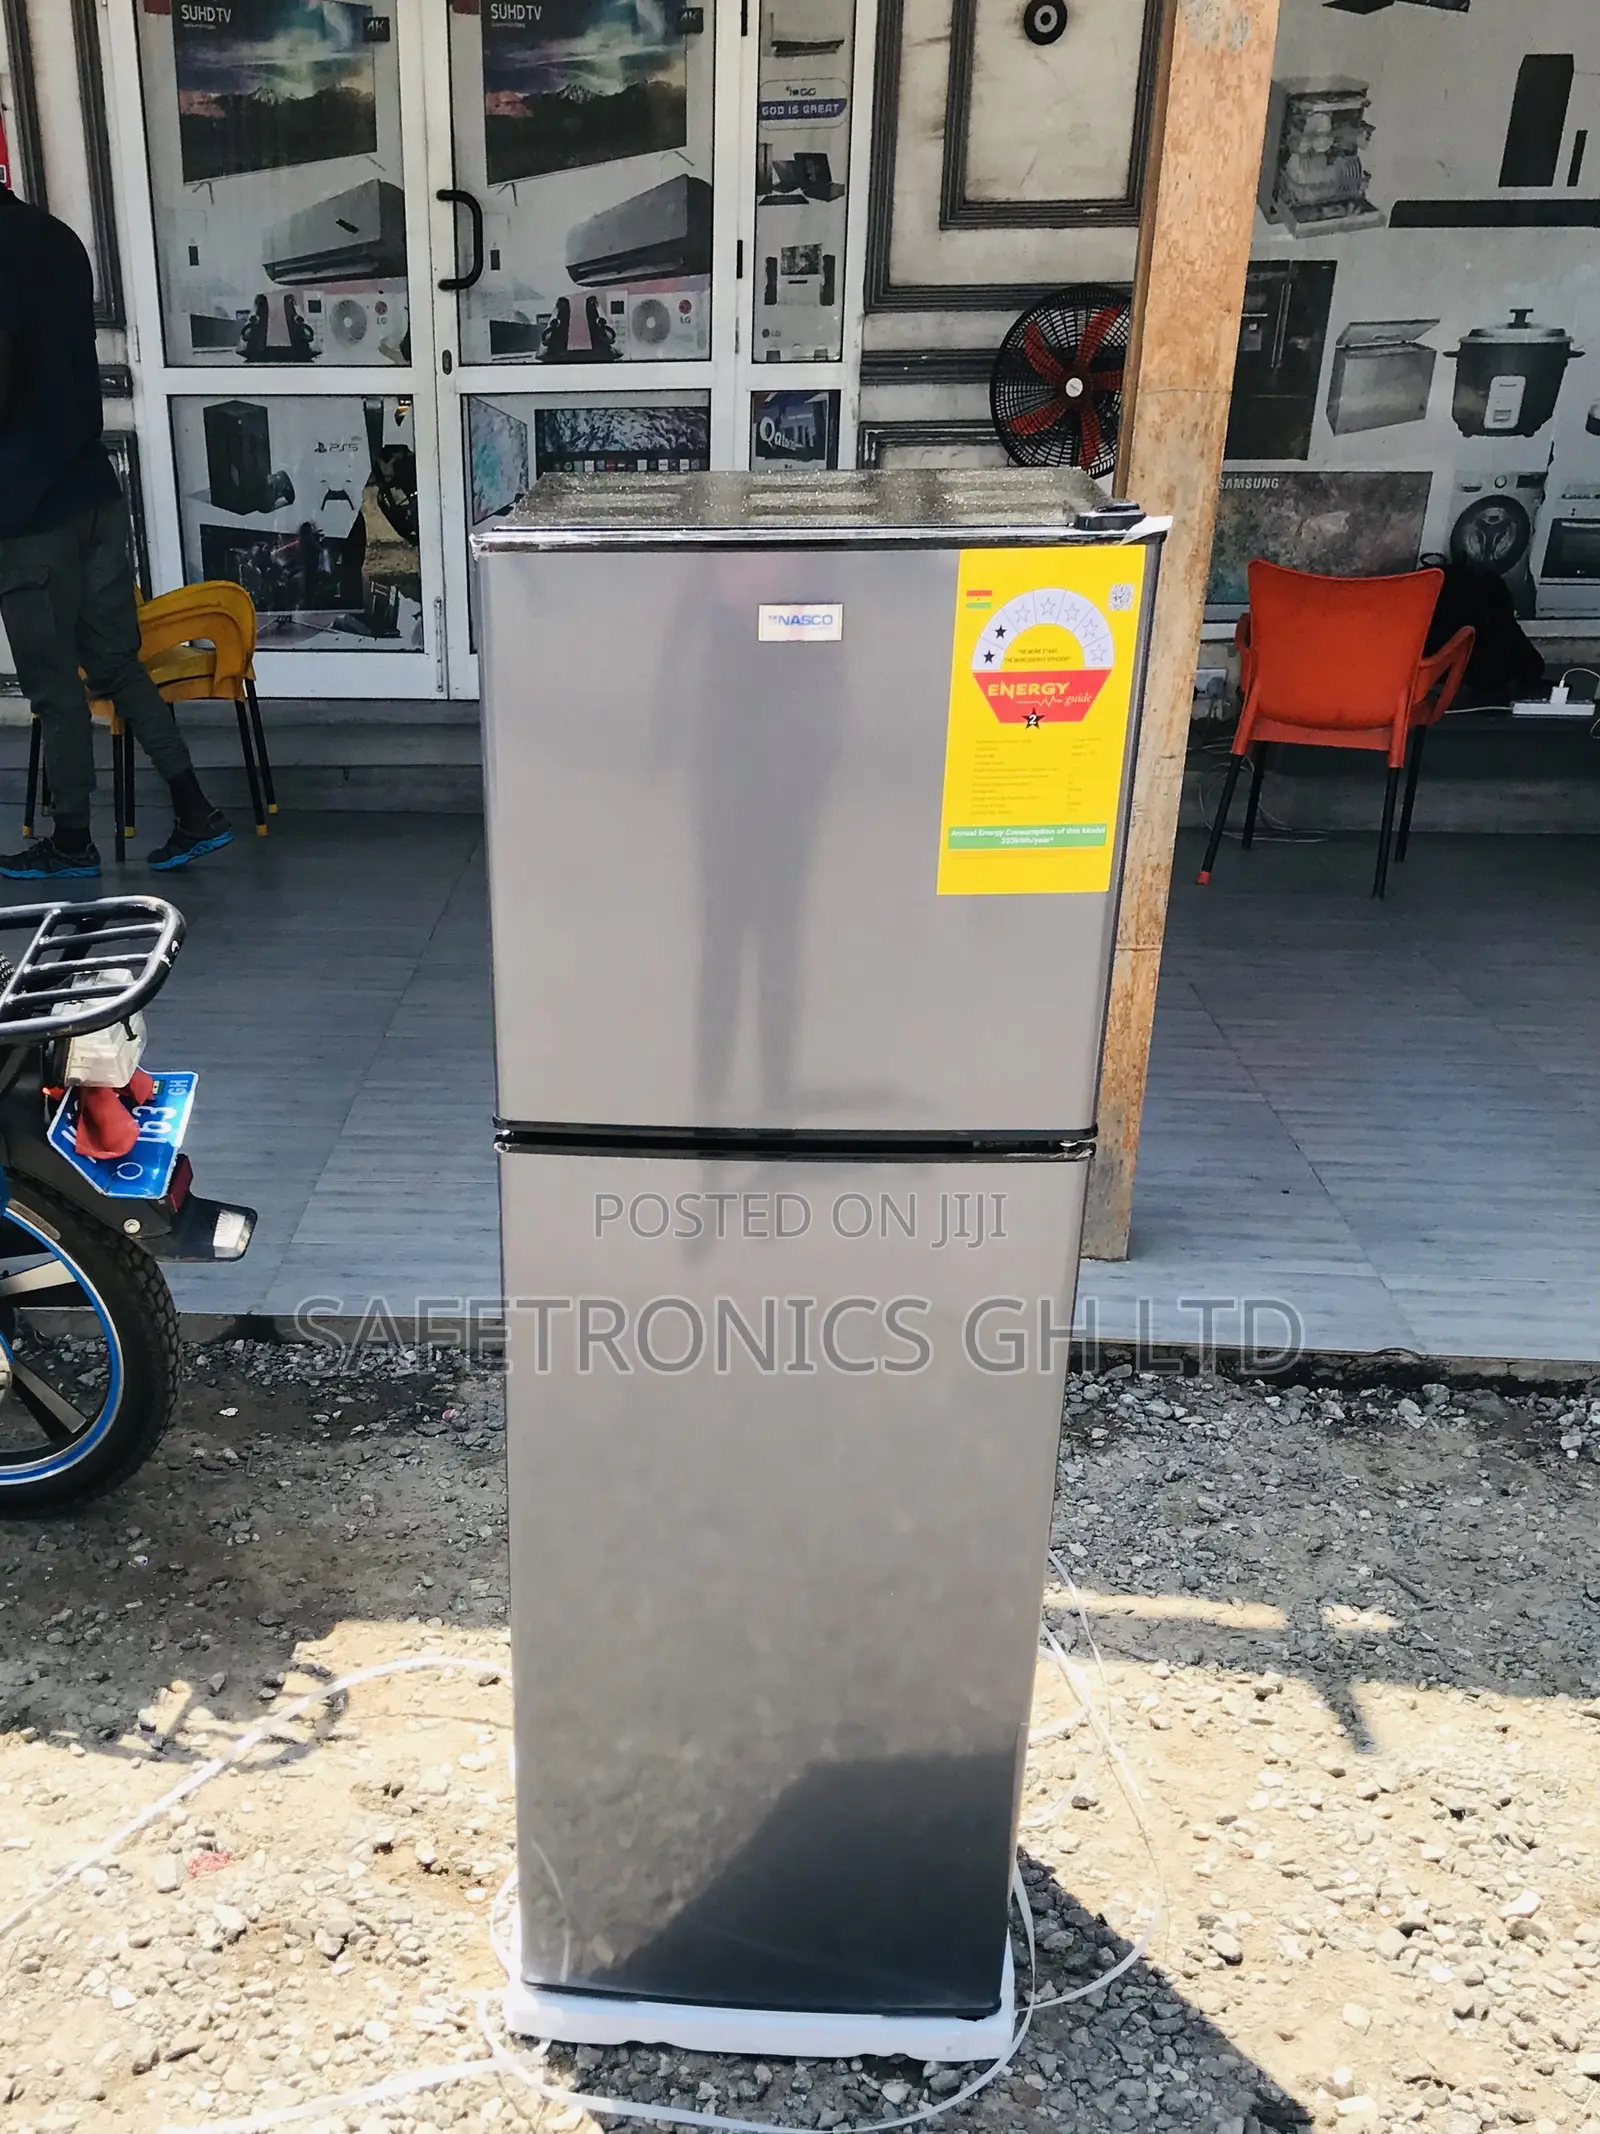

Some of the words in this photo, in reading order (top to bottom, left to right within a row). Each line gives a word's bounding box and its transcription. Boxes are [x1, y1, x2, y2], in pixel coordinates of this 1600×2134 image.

[761, 105, 785, 116] GOD
[788, 104, 799, 115] IS
[802, 103, 840, 115] GREAT
[680, 316, 691, 324] LG
[329, 442, 359, 453] PS5
[1219, 477, 1279, 490] SAMSUNG
[778, 614, 834, 626] NASCO
[987, 680, 1070, 700] ENERGY
[1064, 692, 1093, 707] guide
[1028, 714, 1038, 725] 2
[951, 829, 977, 837] Annual
[978, 829, 1004, 839] Energy
[1005, 828, 1055, 837] Consumption
[1056, 827, 1066, 835] of
[1066, 827, 1081, 835] this
[1081, 825, 1106, 835] Model
[168, 1079, 189, 1096] GH
